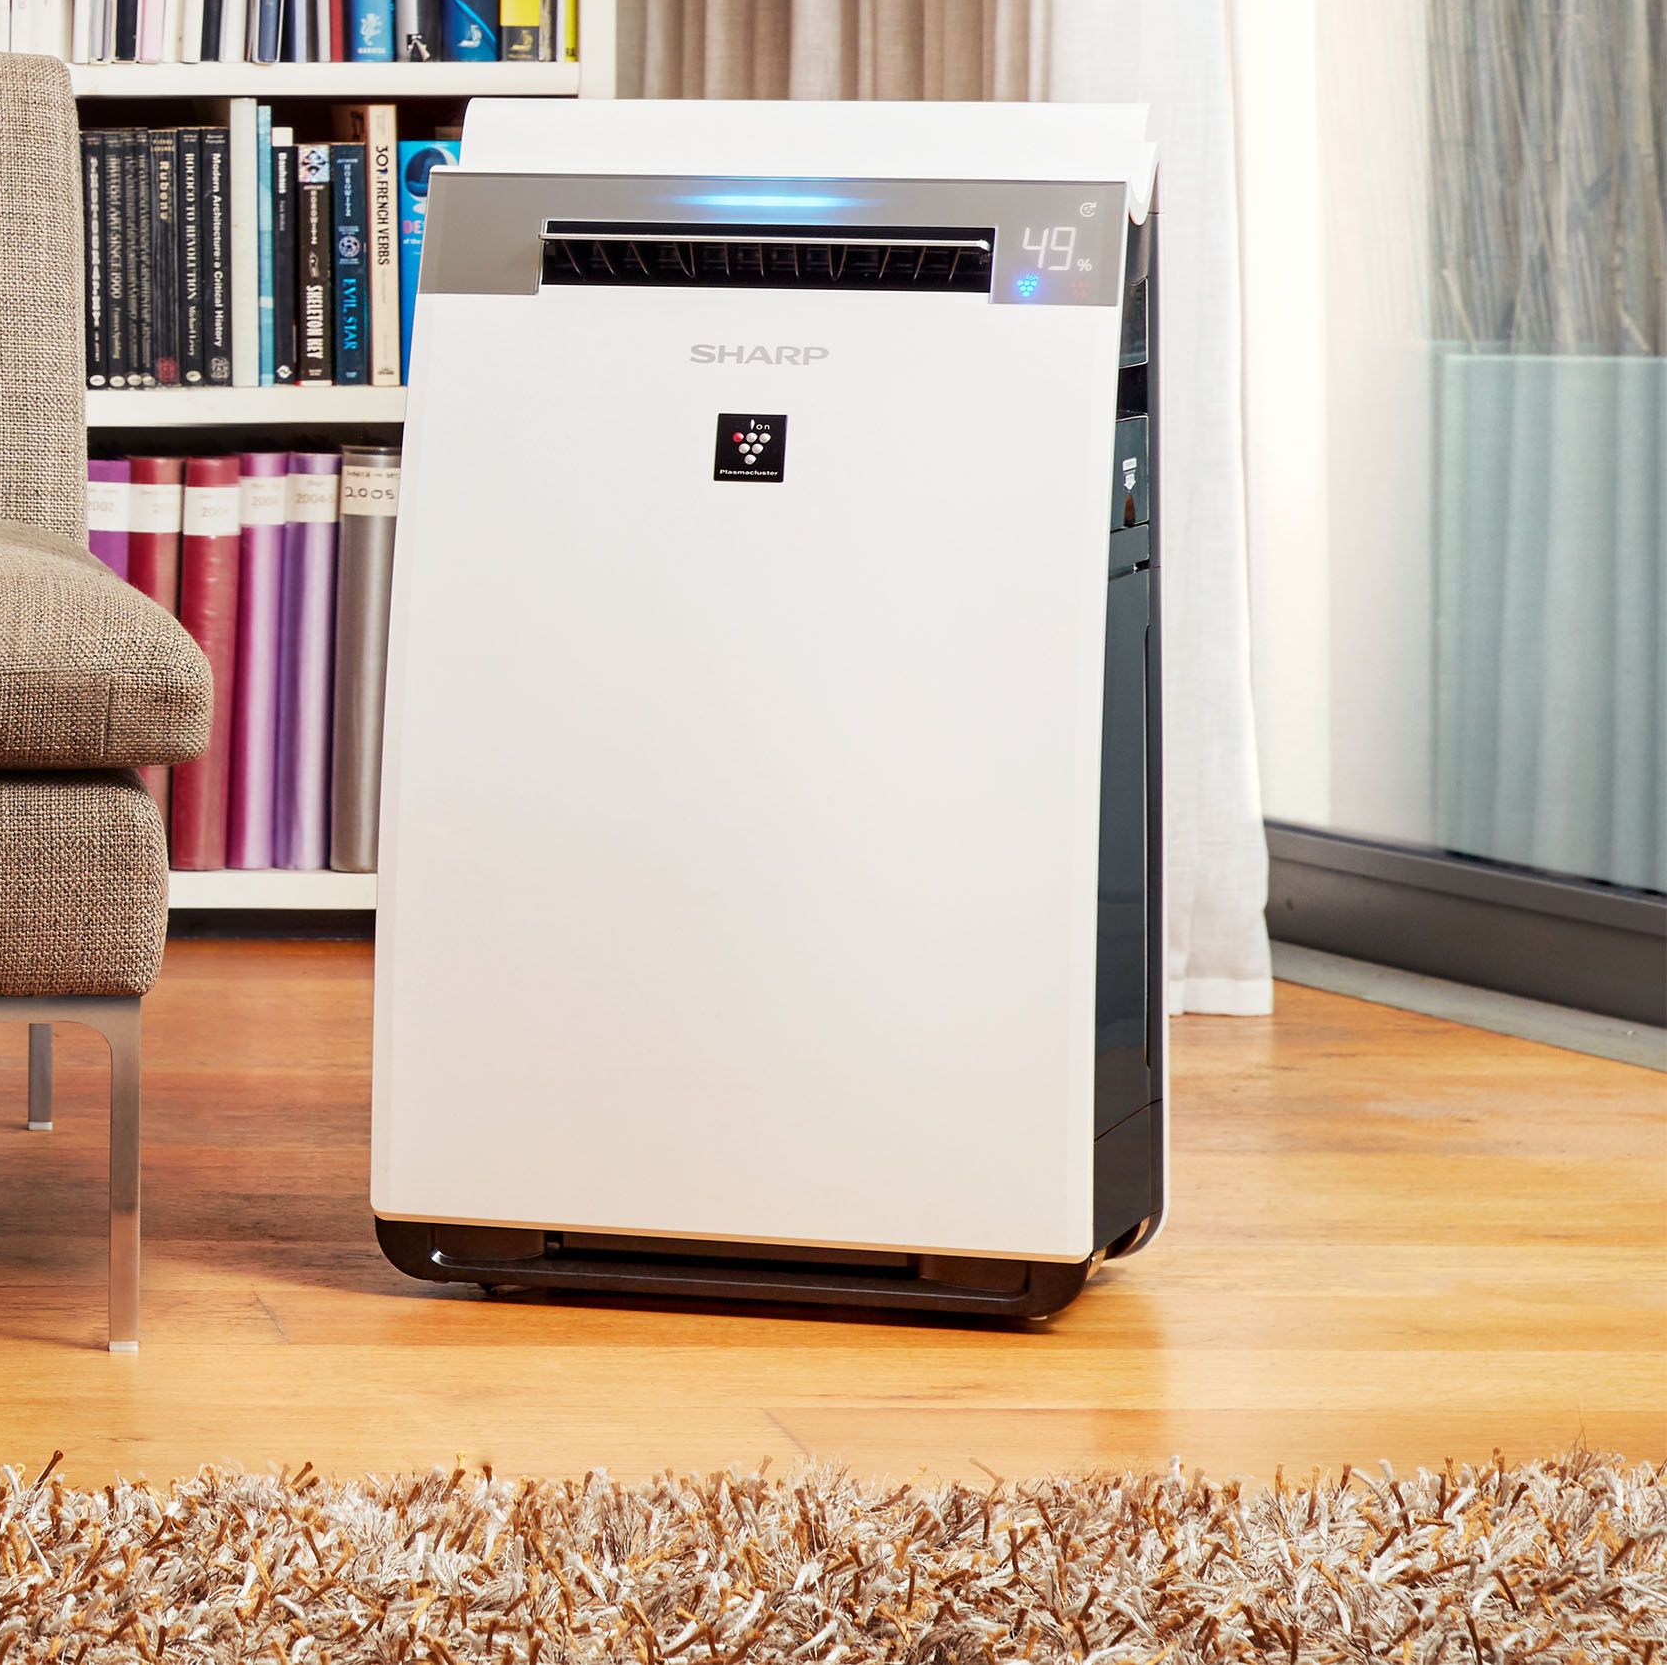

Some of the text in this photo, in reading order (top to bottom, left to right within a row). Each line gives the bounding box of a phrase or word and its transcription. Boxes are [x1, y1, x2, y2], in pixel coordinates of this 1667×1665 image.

[376, 181, 389, 265] FRENCH VERBS
[343, 279, 356, 349] EVIL STAR
[689, 344, 830, 366] SHARP
[719, 468, 779, 477] Plasmacluster
[344, 484, 395, 501] 2005
